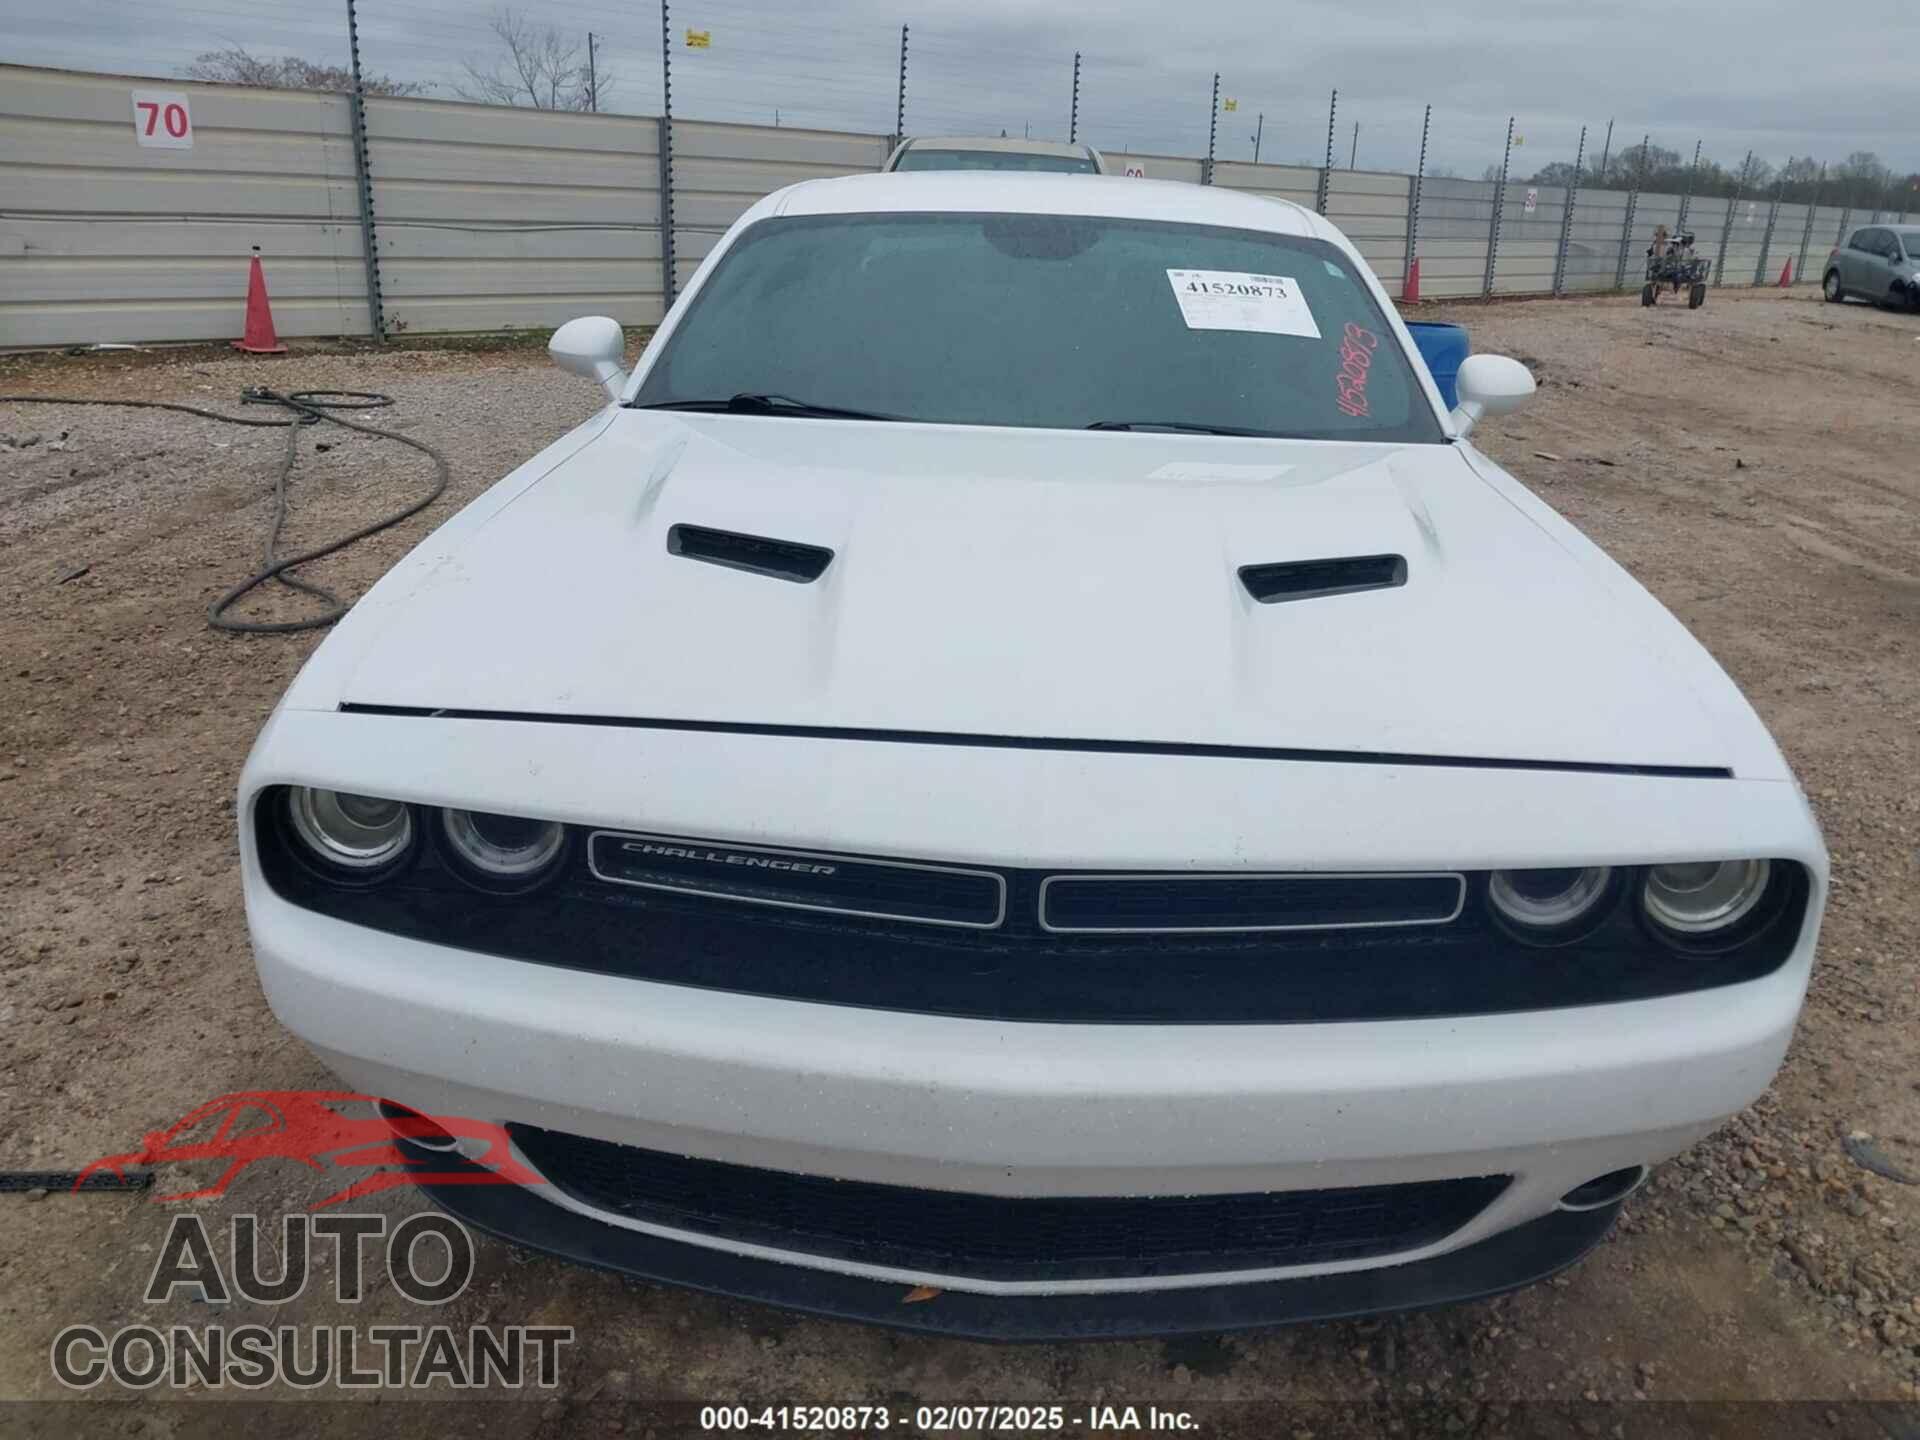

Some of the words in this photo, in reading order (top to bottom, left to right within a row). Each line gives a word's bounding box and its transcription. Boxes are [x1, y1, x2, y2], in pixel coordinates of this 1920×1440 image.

[136, 102, 187, 138] 70
[1186, 281, 1288, 300] 41520873
[621, 841, 836, 876] CHALLENGER
